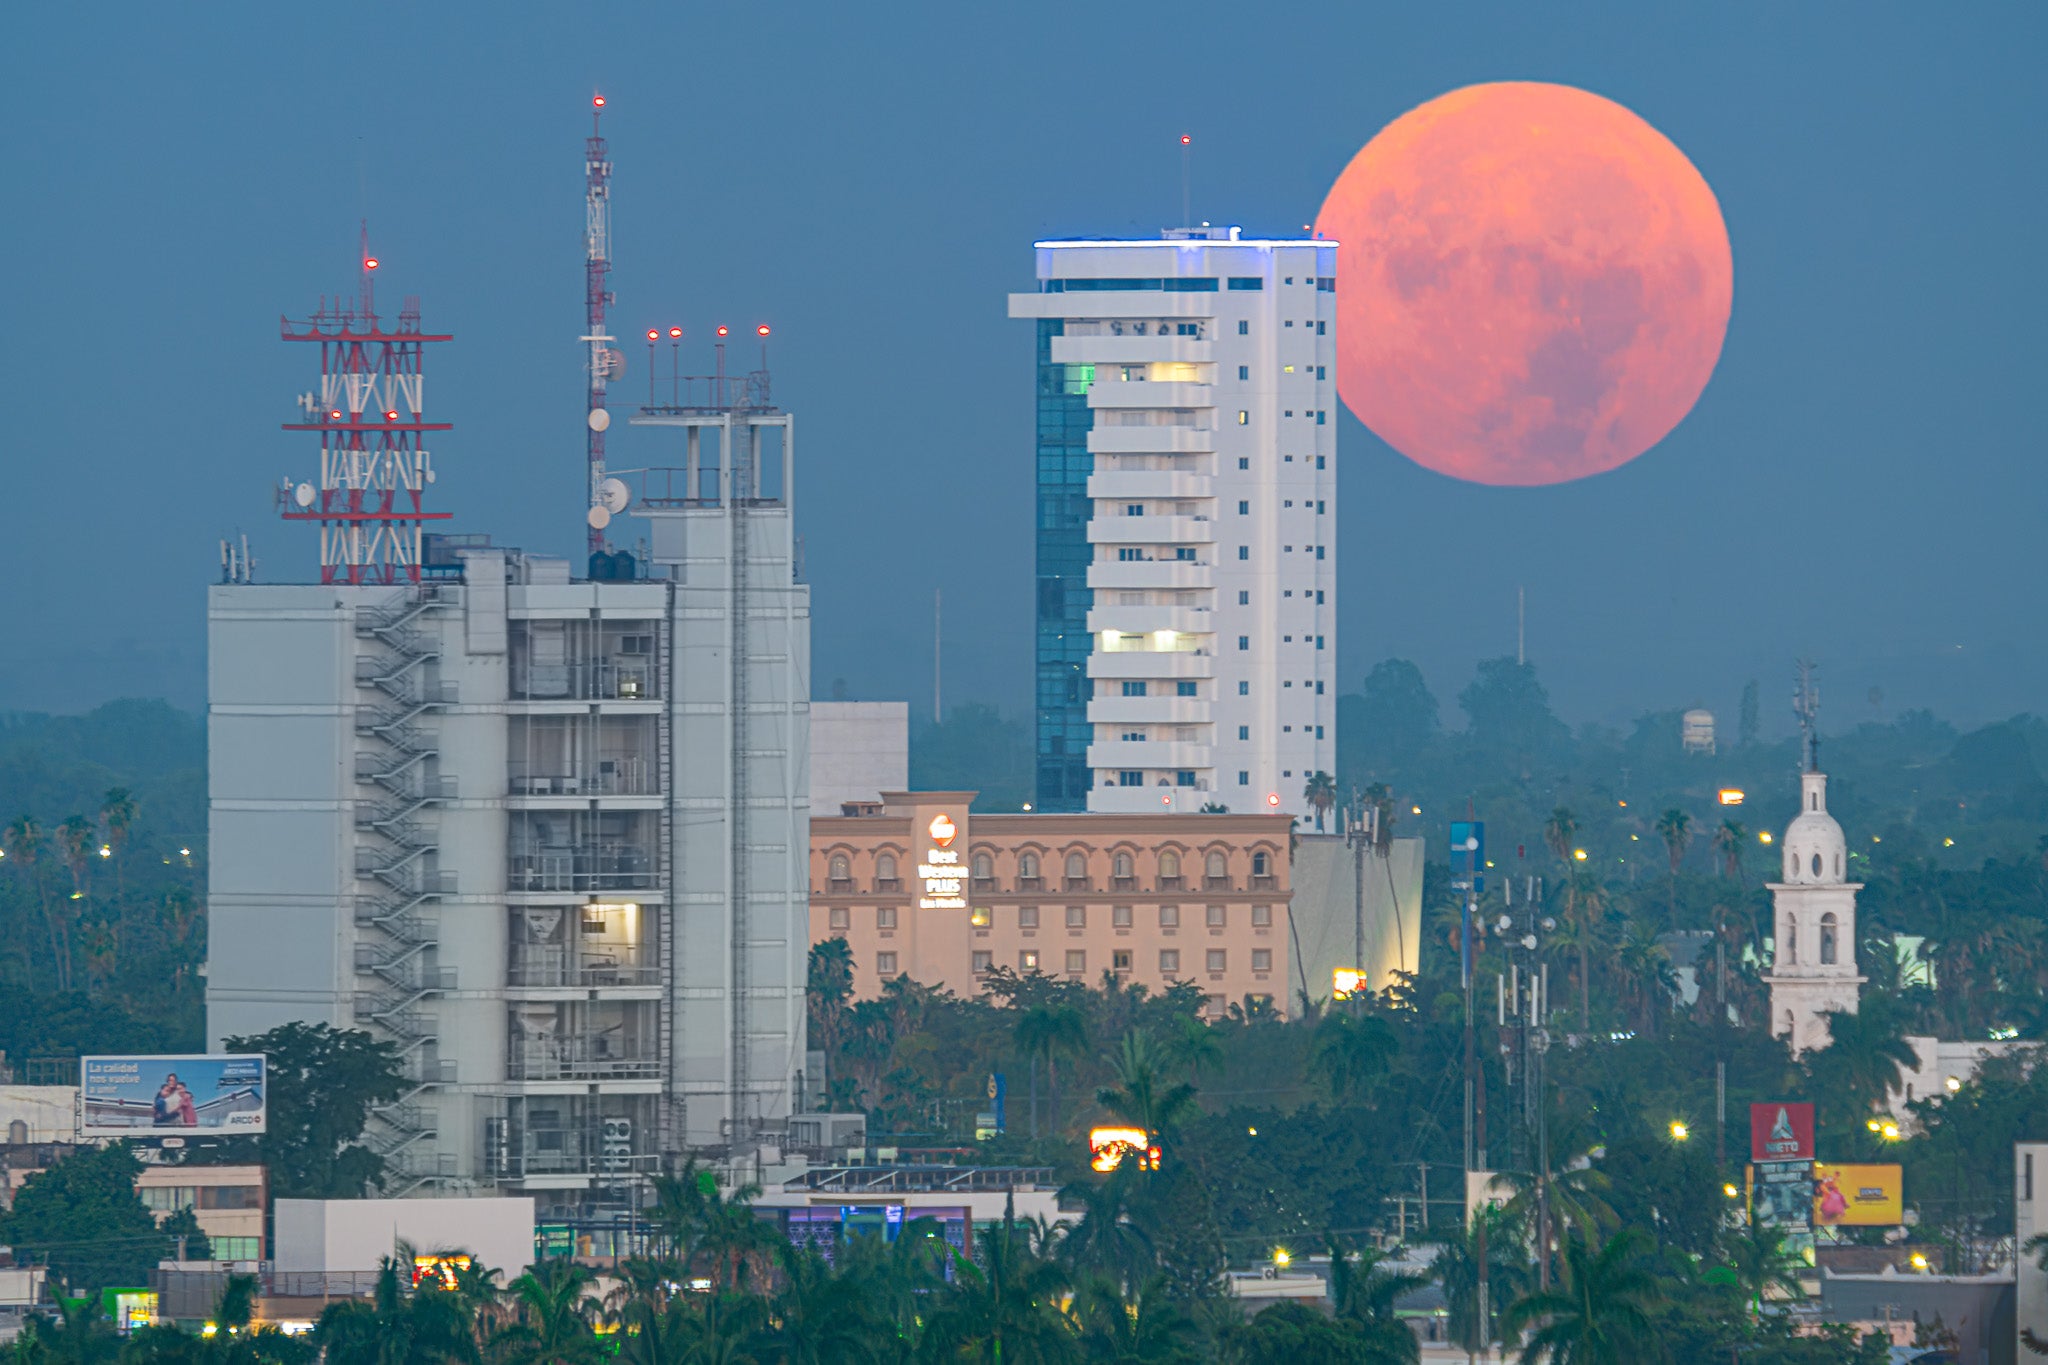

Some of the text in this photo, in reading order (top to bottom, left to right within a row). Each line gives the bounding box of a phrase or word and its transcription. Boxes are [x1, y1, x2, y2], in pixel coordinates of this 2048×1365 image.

[928, 850, 957, 863] Best
[926, 879, 960, 892] PLUS
[89, 1062, 138, 1073] La calidad
[89, 1075, 107, 1084] nos
[231, 1116, 253, 1125] ARCO
[1765, 1141, 1799, 1153] NIETO
